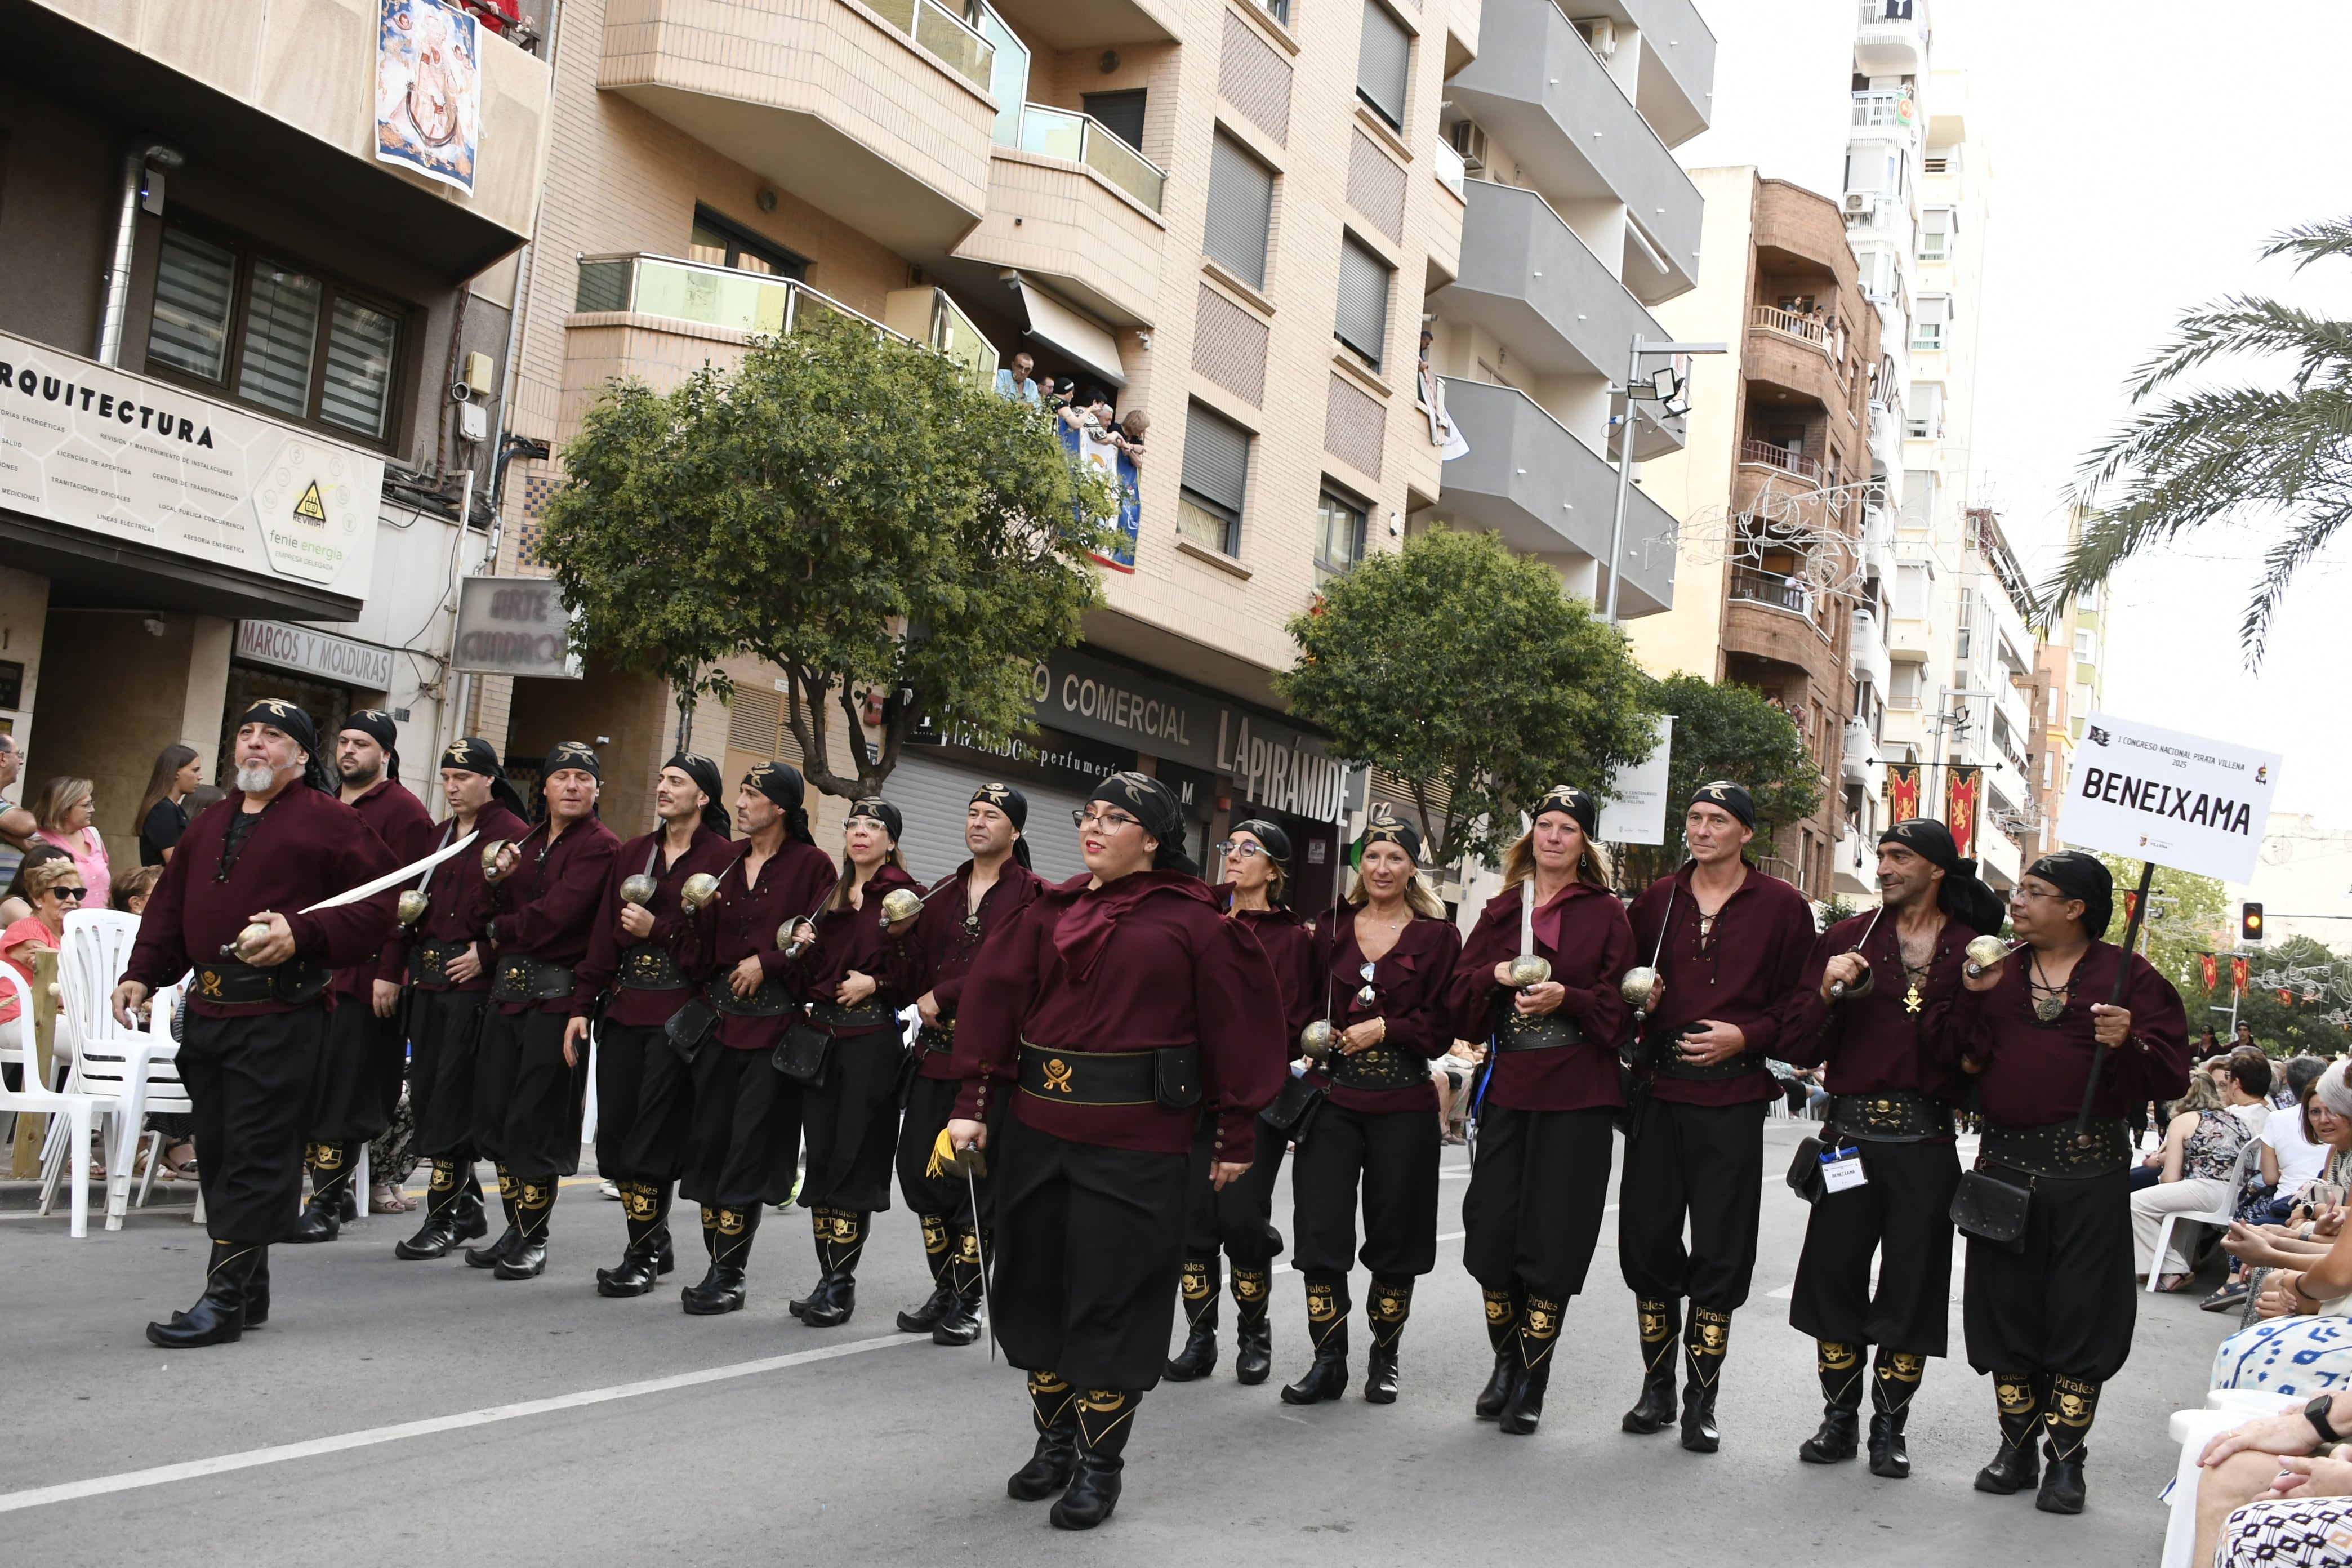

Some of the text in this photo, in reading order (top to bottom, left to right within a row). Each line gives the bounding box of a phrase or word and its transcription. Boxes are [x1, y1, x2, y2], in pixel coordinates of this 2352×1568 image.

[2, 438, 22, 448] SALUD
[57, 450, 88, 463] LICENCIAS
[101, 462, 131, 475] APERTURA
[135, 444, 180, 461] MANTENIMIENTO
[191, 460, 233, 476] INSTALACIONES
[51, 476, 131, 502] TRAMITACIONES OFICIALES
[152, 473, 179, 484] CENTROS
[2, 488, 40, 502] MEDICIONES
[158, 503, 176, 513] LOCAL
[204, 515, 245, 531] CONCURRENCIA
[293, 513, 326, 529] REVIMAT
[275, 550, 333, 571] EMPRESA DELEGADA
[241, 620, 387, 683] MARCOS Y MOLDURAS
[1063, 674, 1190, 746] COMERCIAL
[1040, 749, 1122, 778] perfumerí
[2123, 737, 2158, 751] CONGRESO
[2159, 745, 2191, 759] NACIONAL
[2193, 752, 2216, 765] PIRATA
[2217, 758, 2245, 771] VILLENA
[2172, 759, 2187, 769] 2025
[1181, 781, 1195, 805] M
[2082, 767, 2251, 836] BENEIXAMA
[1832, 1169, 1855, 1178] BENEIXAMA
[1527, 1293, 1559, 1311] Pirates
[1695, 1306, 1731, 1322] Pirates
[2055, 1373, 2095, 1395] Pirates
